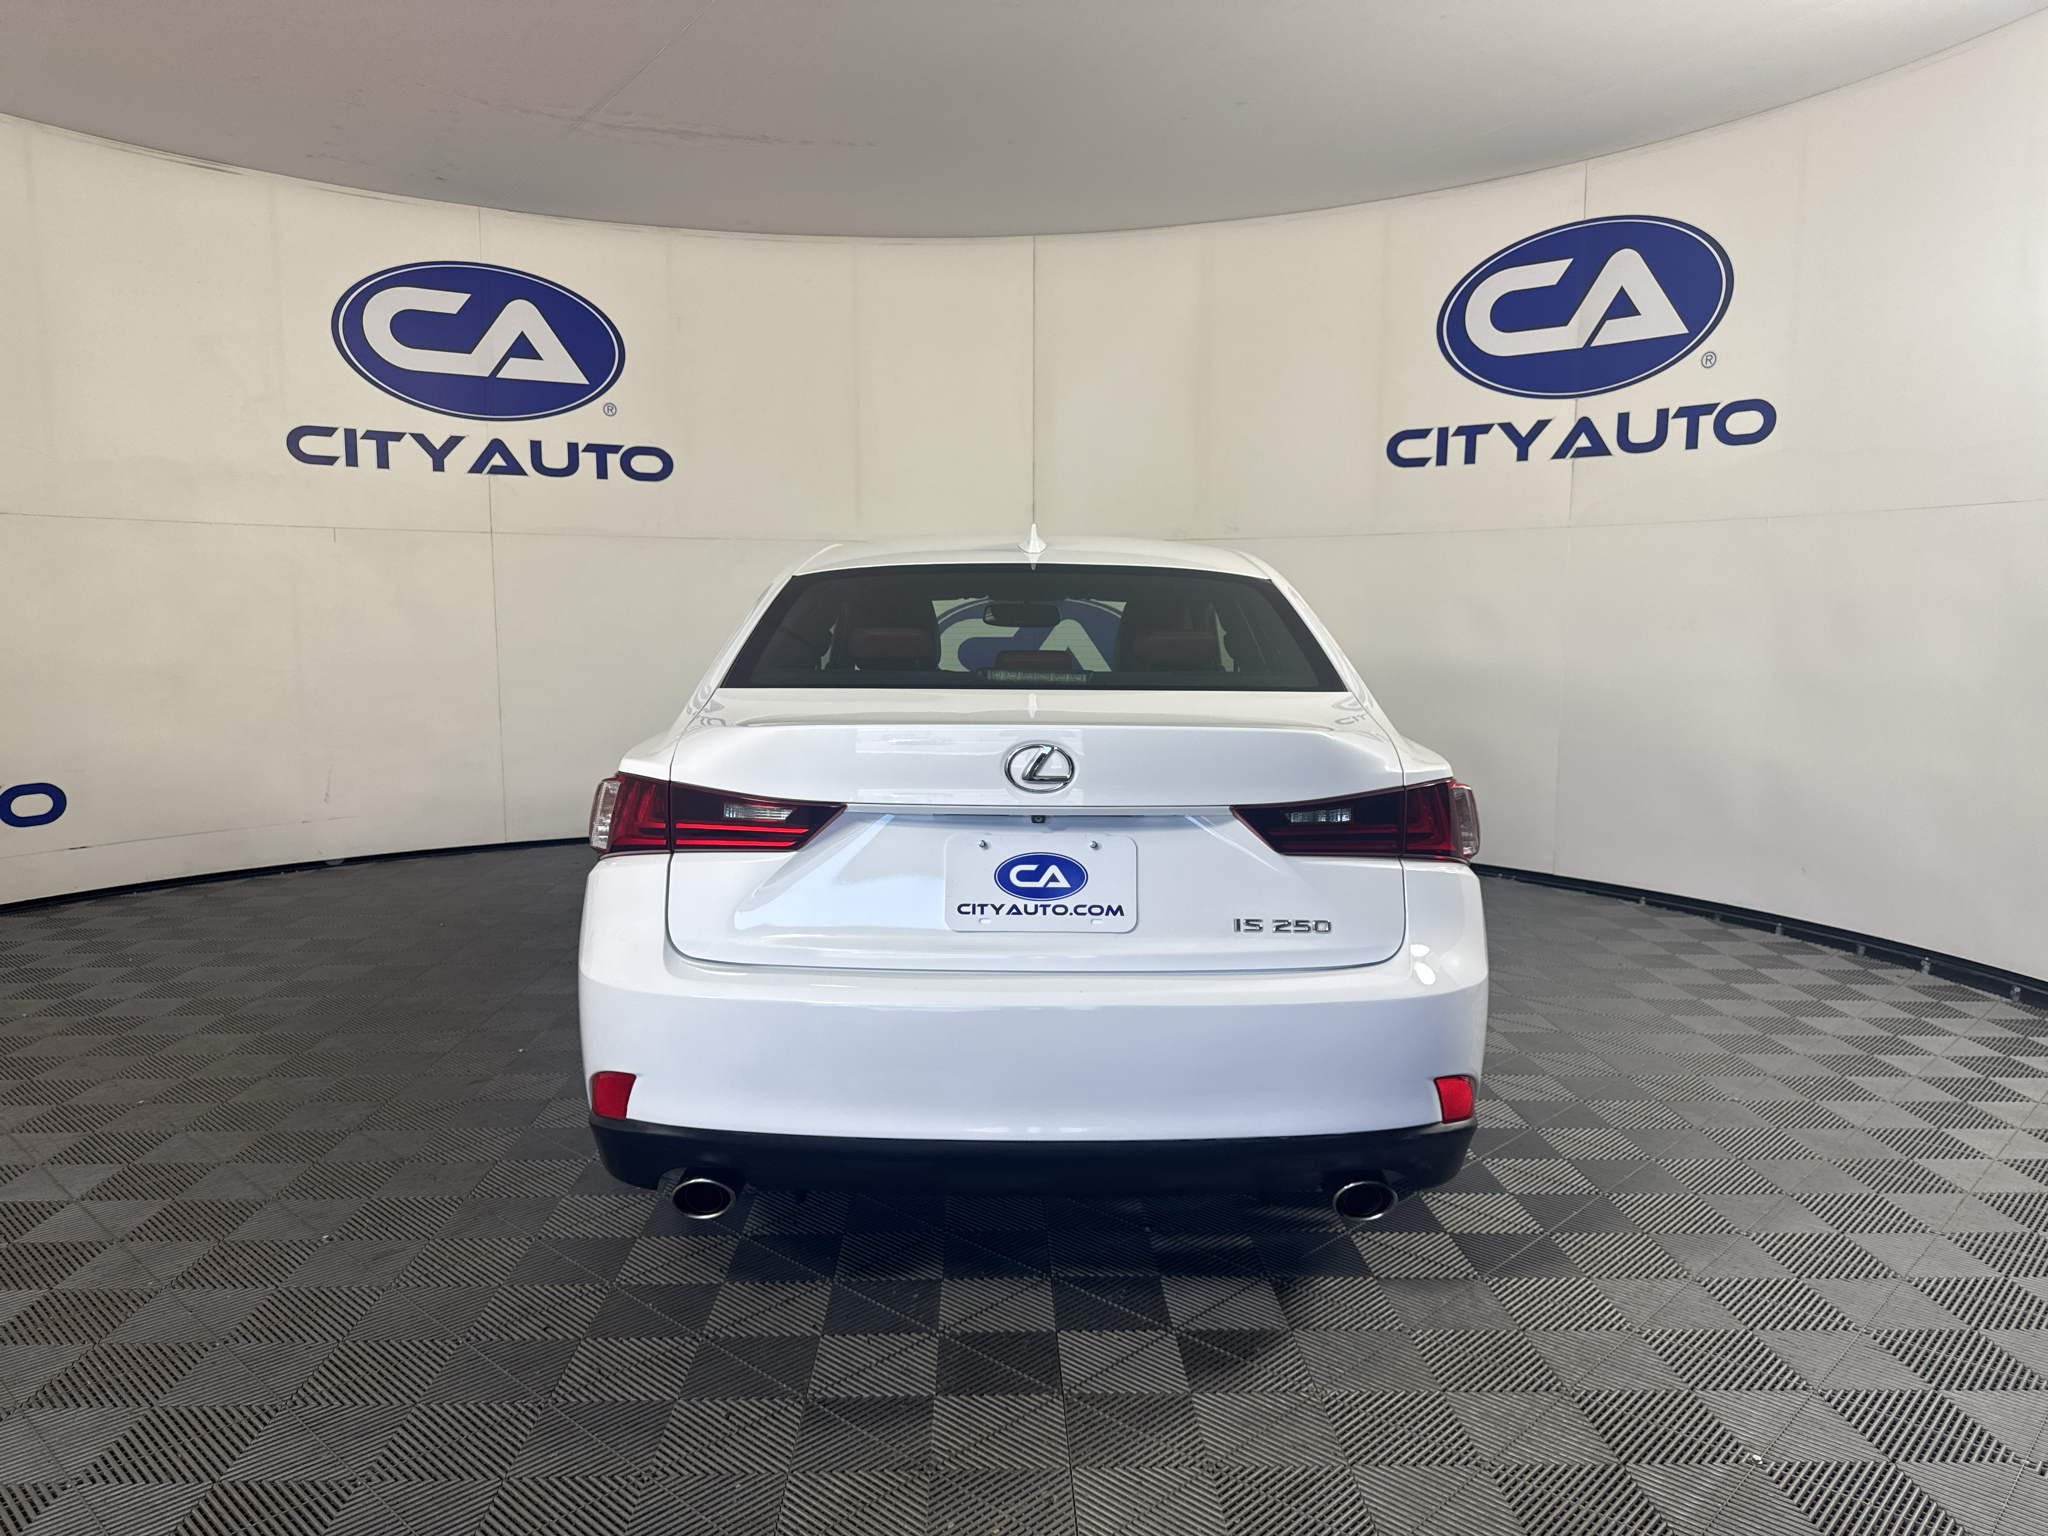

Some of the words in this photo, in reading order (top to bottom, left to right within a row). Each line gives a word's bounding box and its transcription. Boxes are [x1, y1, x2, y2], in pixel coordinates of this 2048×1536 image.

[957, 903, 1125, 916] CITYAUTO.COM
[1233, 918, 1263, 933] IS
[1272, 918, 1332, 933] 250
